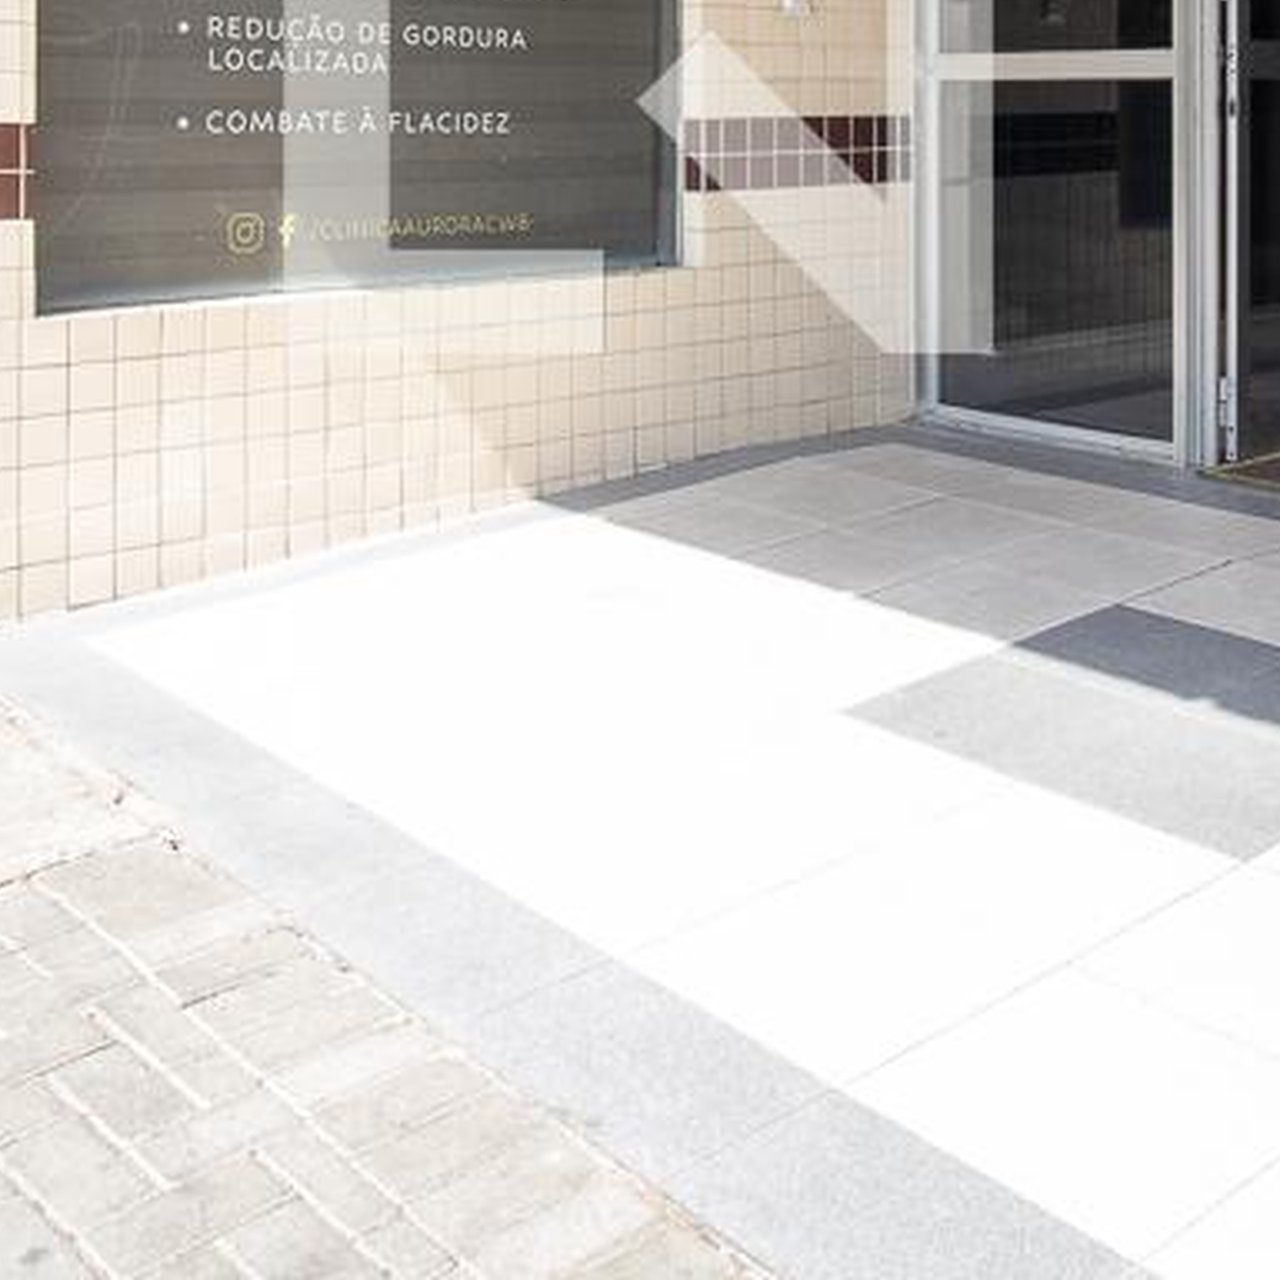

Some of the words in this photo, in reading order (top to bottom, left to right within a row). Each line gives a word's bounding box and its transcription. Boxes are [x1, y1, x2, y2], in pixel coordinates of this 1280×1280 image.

[207, 15, 345, 45] REDUÇÃO
[358, 24, 391, 45] DE
[403, 24, 527, 50] GORDURA
[208, 49, 388, 75] LOCALIZADA
[206, 110, 348, 135] COMBATE
[359, 107, 377, 135] À
[390, 112, 510, 135] FLACIDEZ
